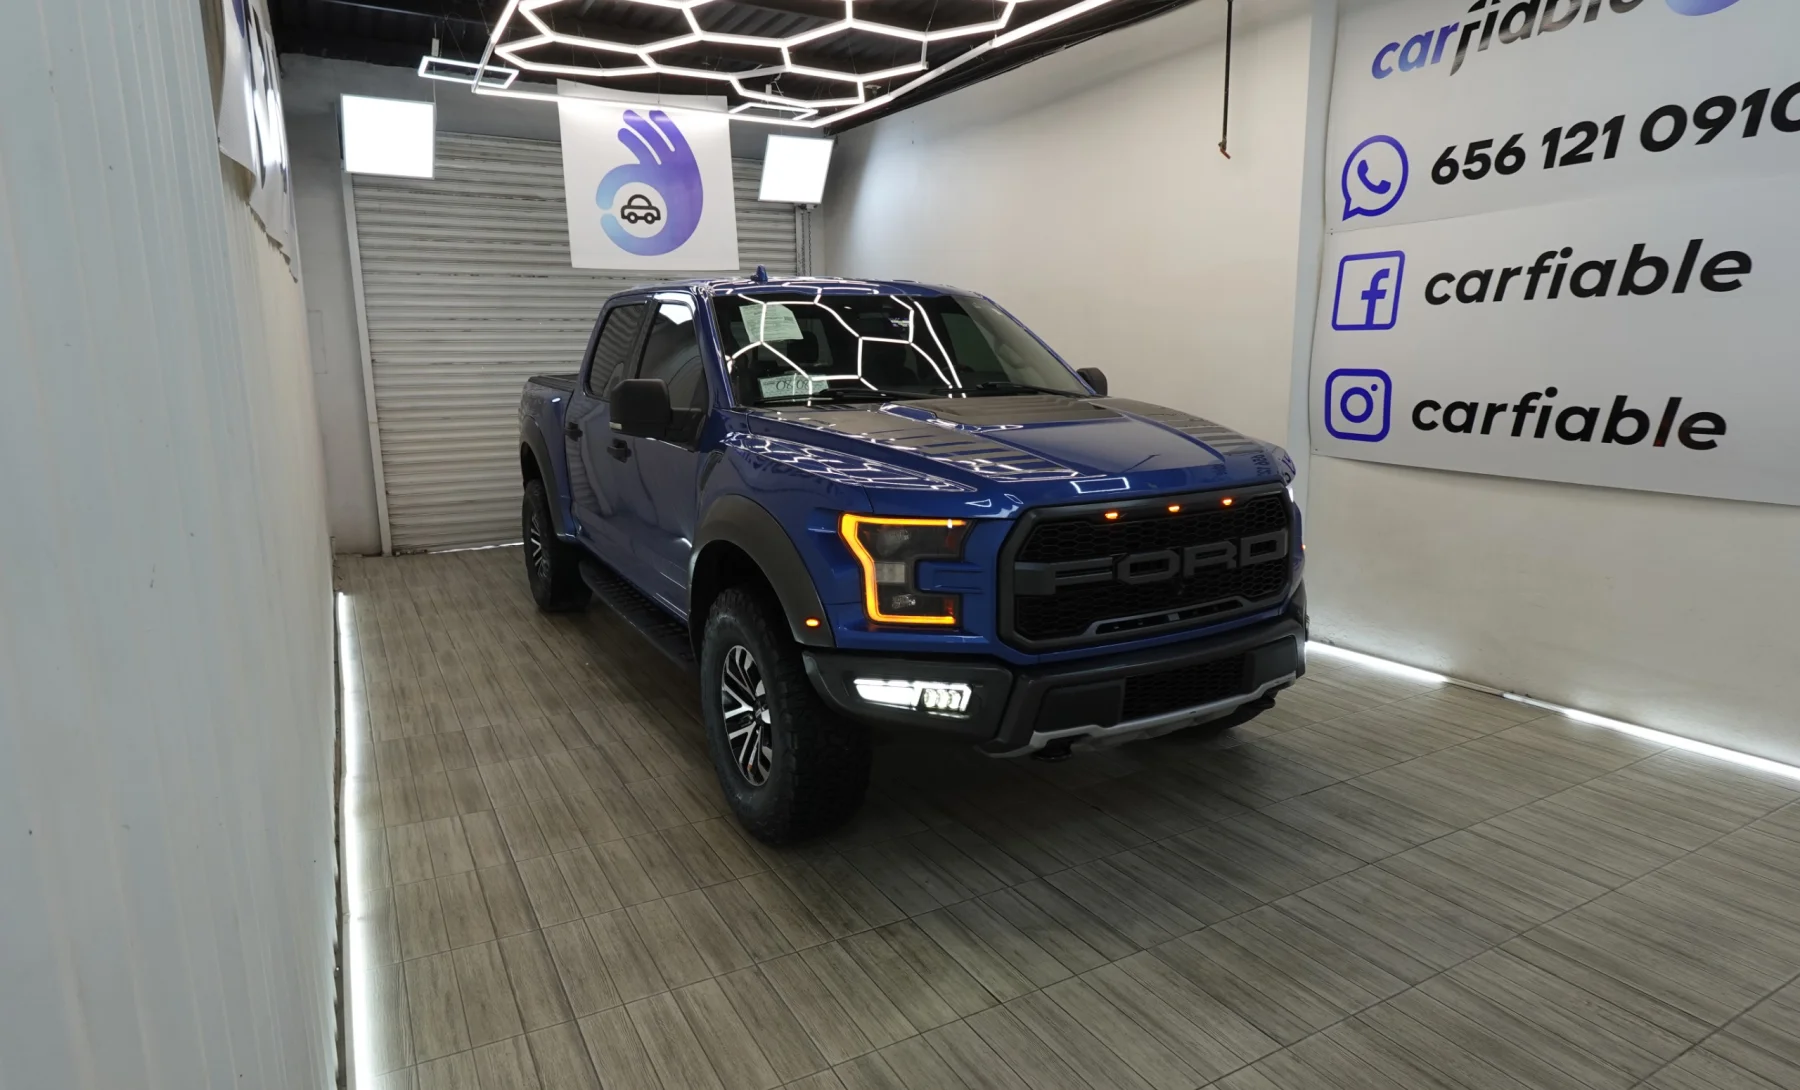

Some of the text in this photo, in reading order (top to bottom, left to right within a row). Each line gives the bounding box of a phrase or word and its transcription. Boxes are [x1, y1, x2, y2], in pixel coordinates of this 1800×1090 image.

[1431, 133, 1526, 185] 656
[1541, 115, 1626, 170] 121
[1424, 238, 1753, 306] carfiable
[1411, 386, 1727, 451] carfiable
[1035, 529, 1288, 596] FORD
